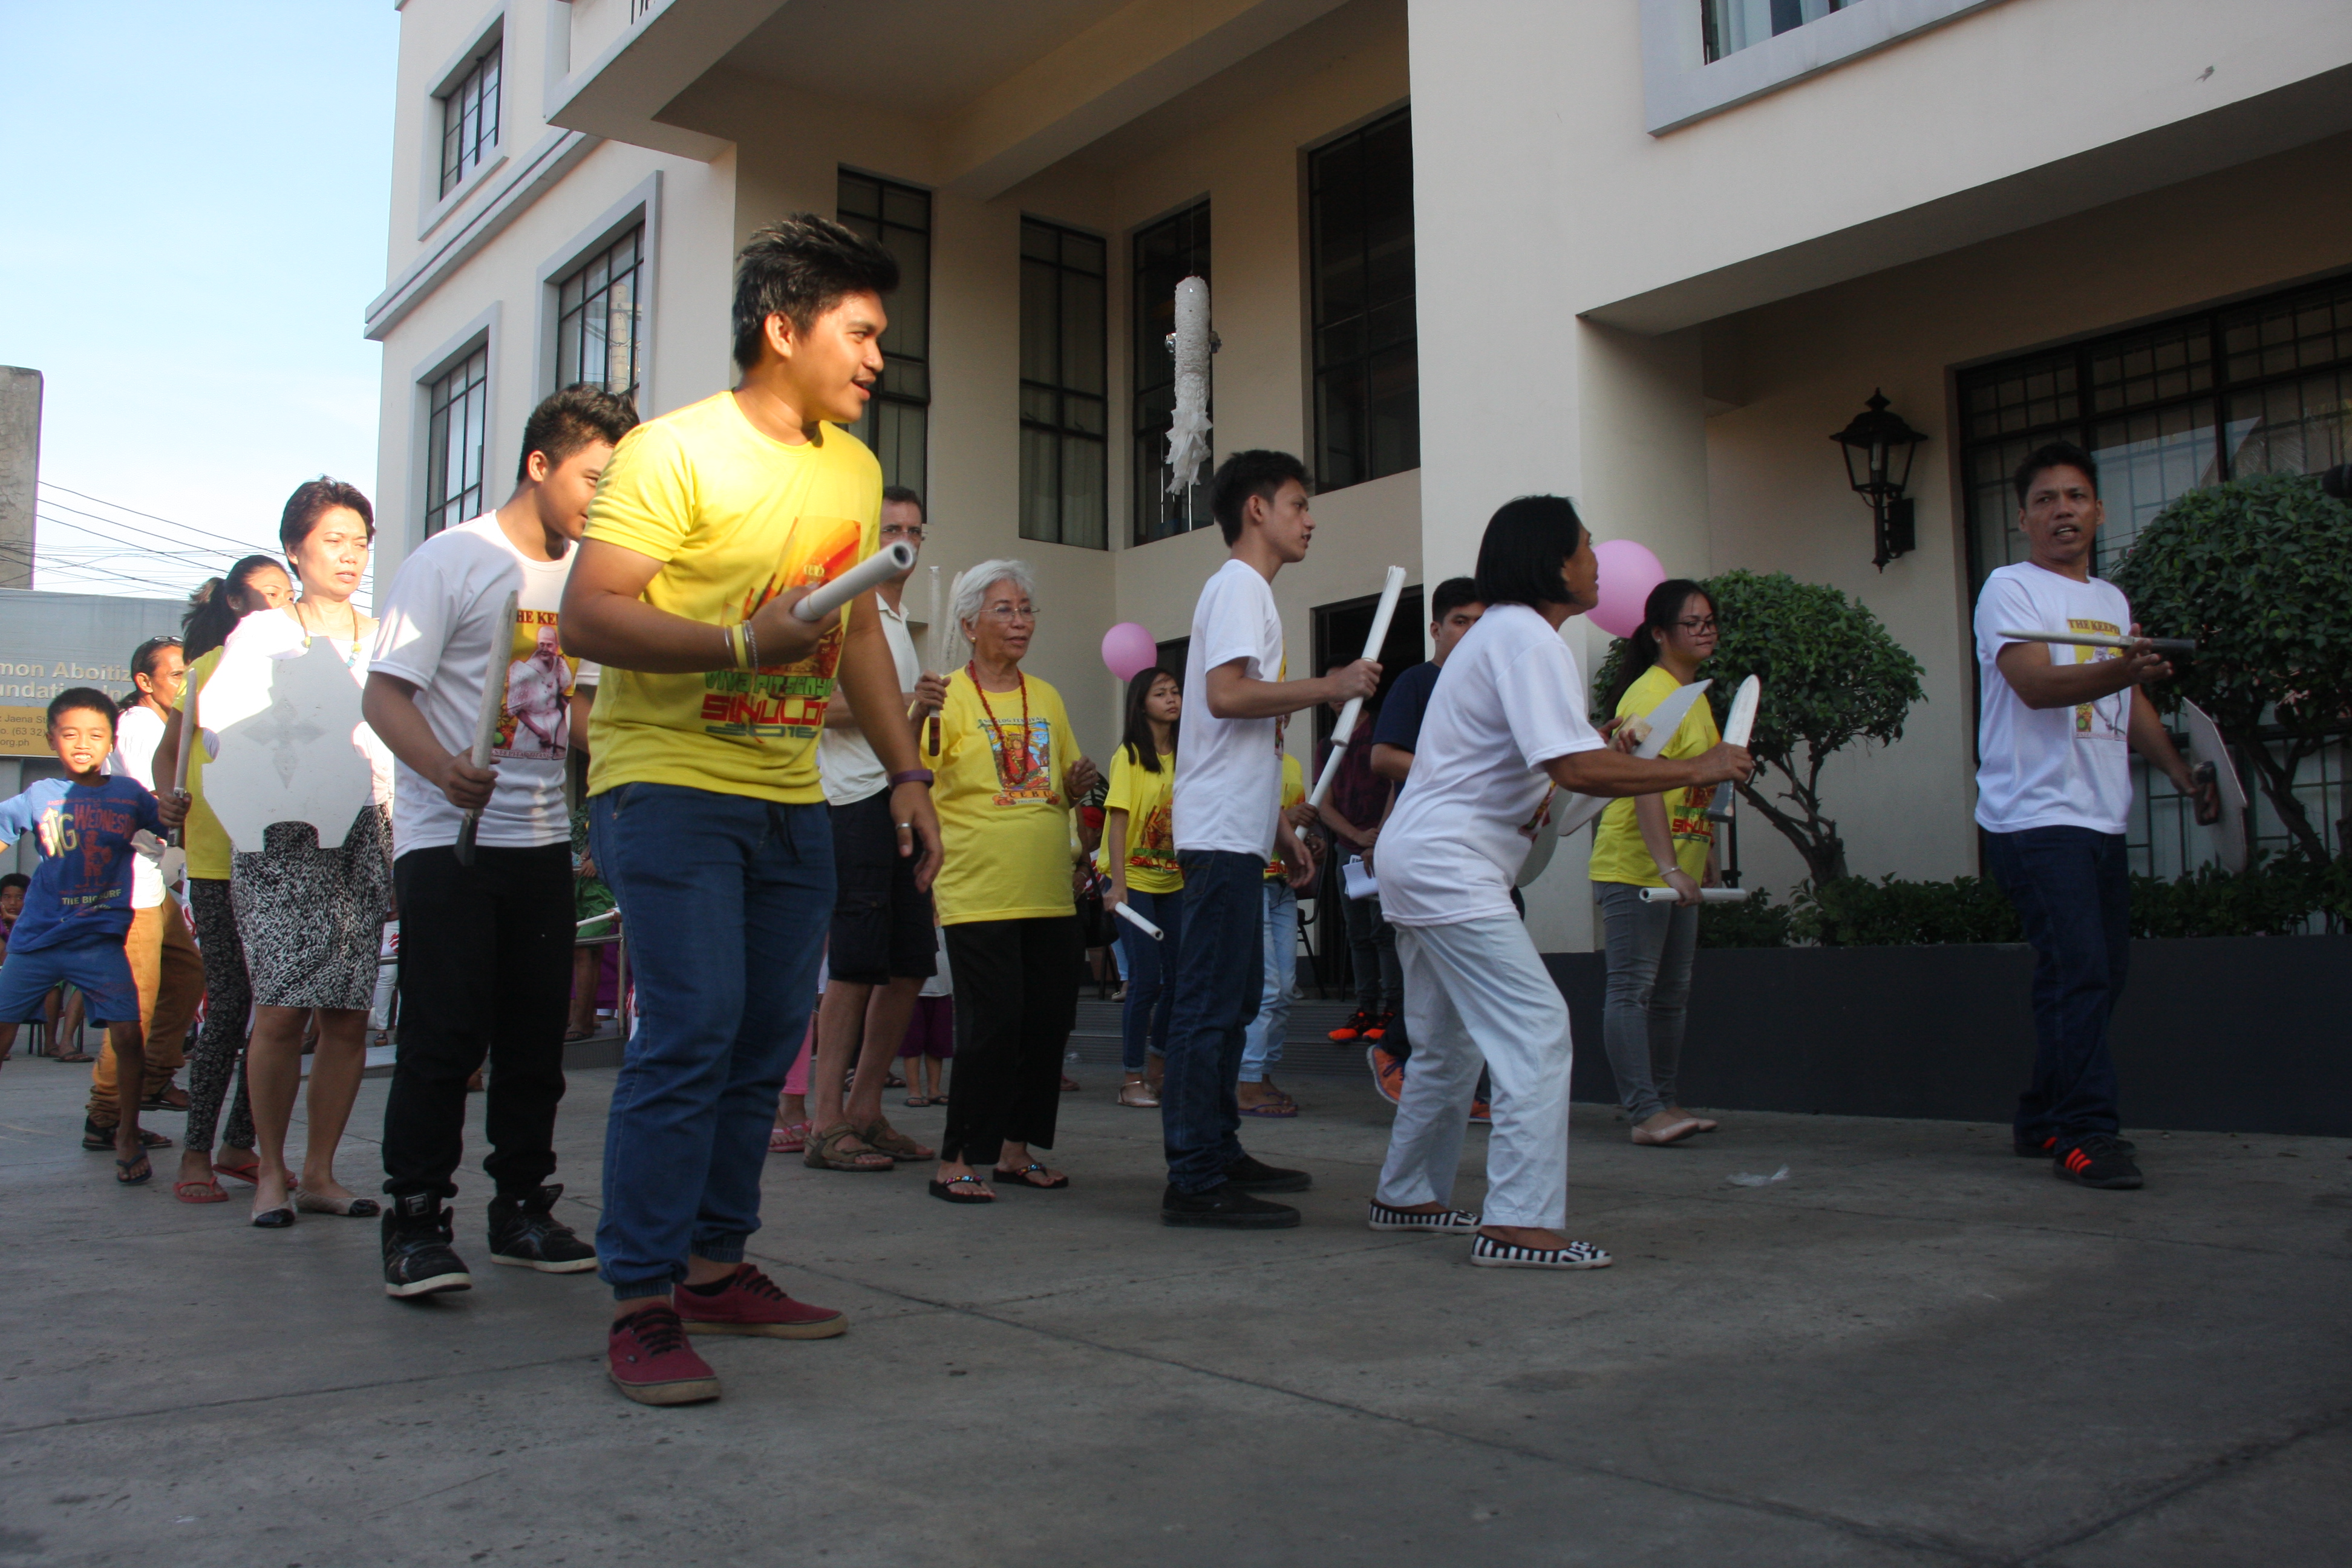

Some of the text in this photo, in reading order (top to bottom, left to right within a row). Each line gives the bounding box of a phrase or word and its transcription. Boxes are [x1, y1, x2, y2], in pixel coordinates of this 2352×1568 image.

[517, 610, 558, 626] HE KE
[52, 662, 132, 682] Aboitiz
[0, 681, 65, 699] ndati
[5, 714, 33, 723] Jaena
[705, 722, 818, 739] 2016
